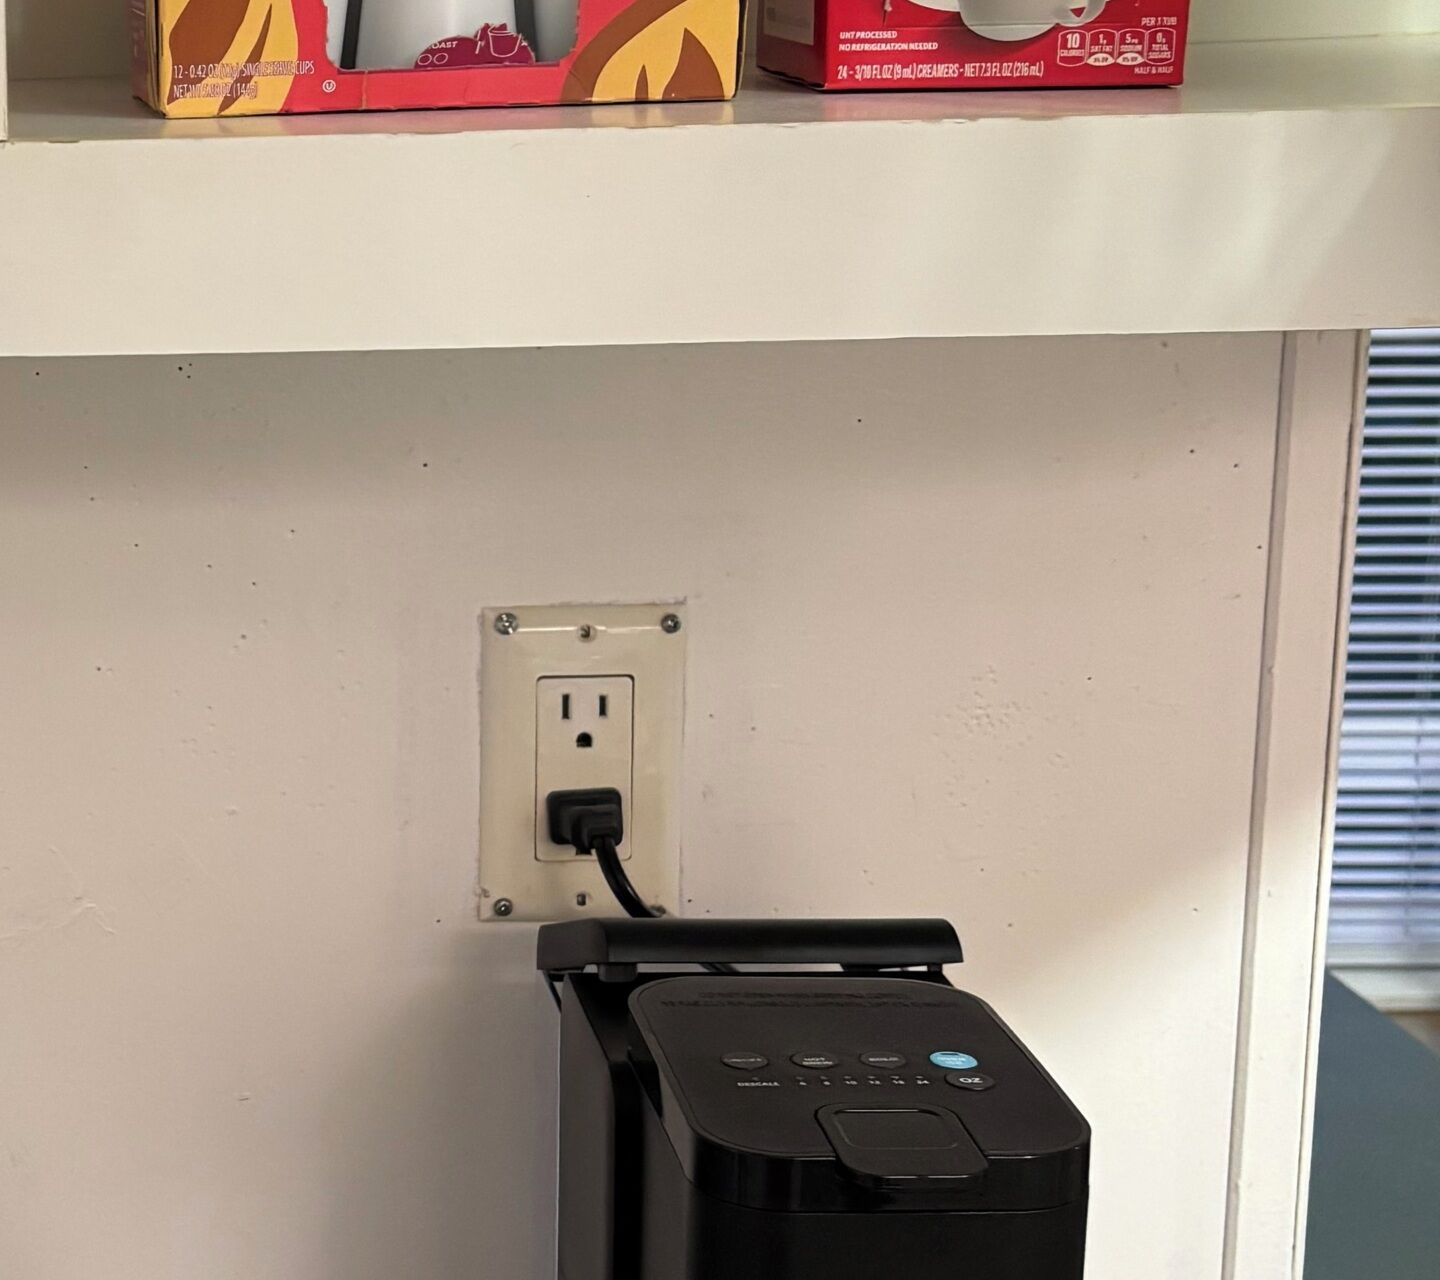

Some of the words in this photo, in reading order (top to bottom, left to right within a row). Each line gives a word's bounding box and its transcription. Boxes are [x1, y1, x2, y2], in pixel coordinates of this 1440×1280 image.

[429, 40, 458, 49] OAST
[1066, 32, 1081, 49] 10
[173, 64, 184, 79] 12
[294, 60, 315, 75] CUPS
[838, 65, 848, 80] 24
[917, 63, 959, 78] CREAMERS
[964, 62, 980, 78] NET
[173, 83, 187, 99] NET
